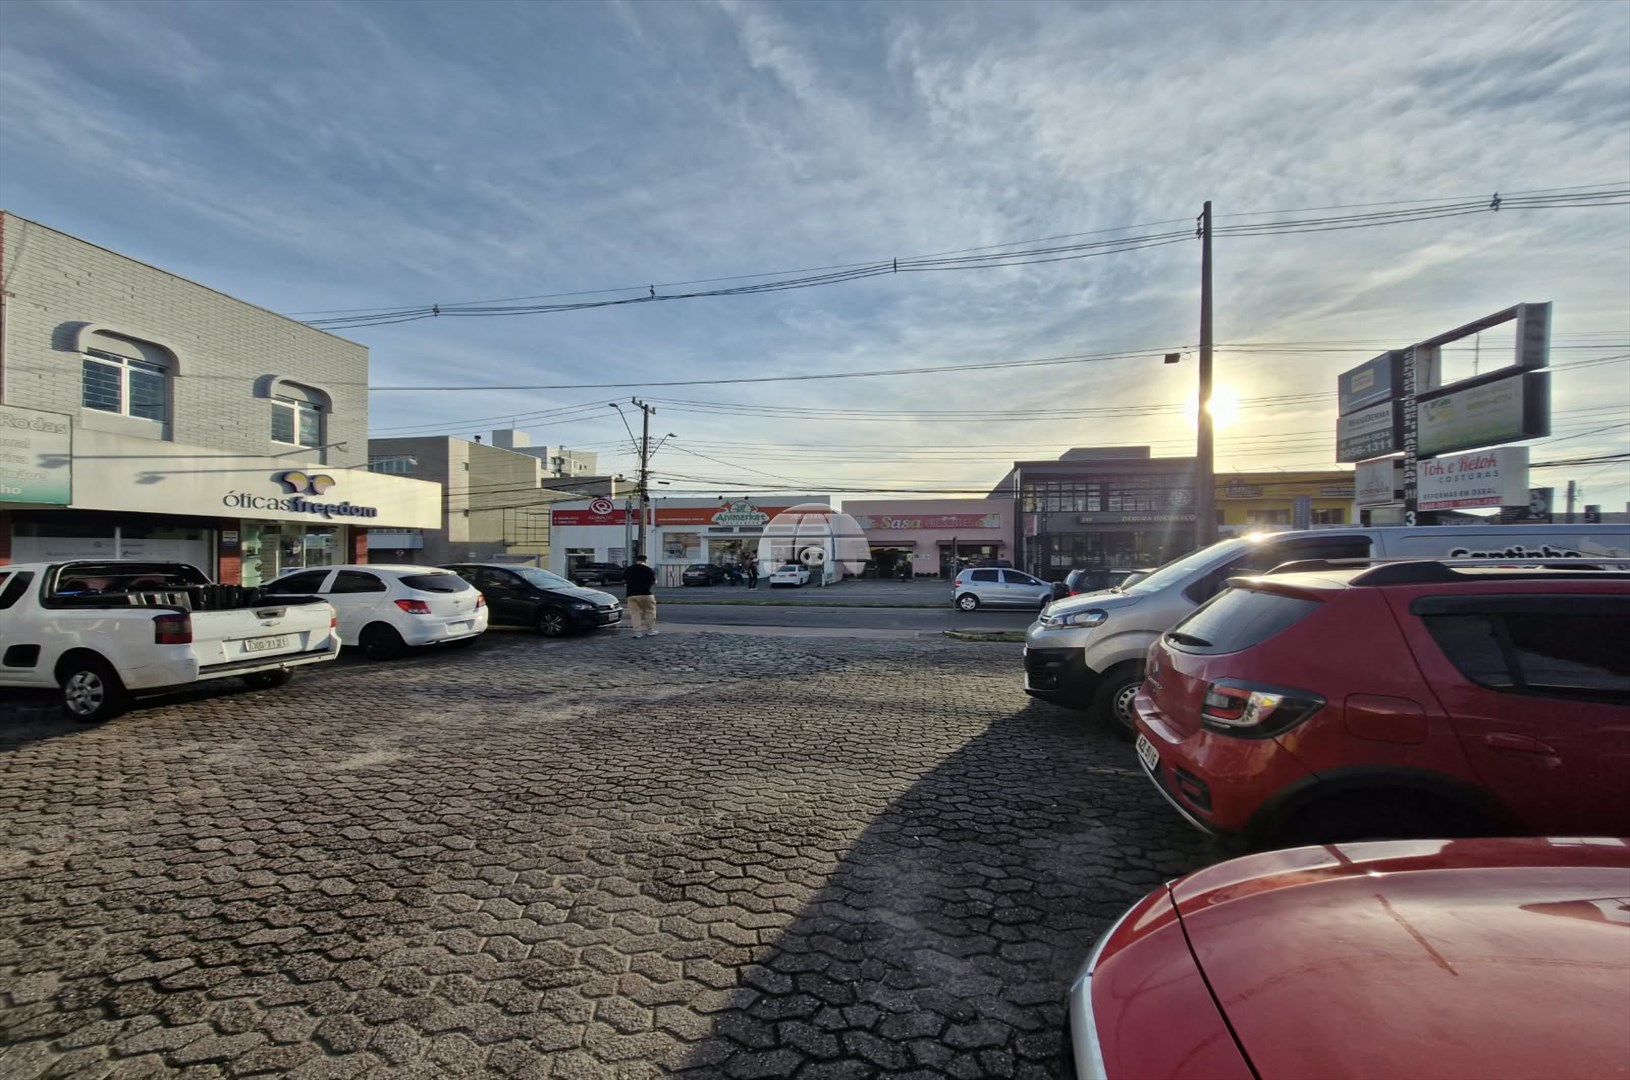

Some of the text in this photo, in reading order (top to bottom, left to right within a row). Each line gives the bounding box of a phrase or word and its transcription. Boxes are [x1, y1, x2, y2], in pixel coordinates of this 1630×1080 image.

[0, 411, 67, 434] Rodas
[1439, 470, 1499, 483] COSTURAS
[880, 516, 922, 529] Sasa
